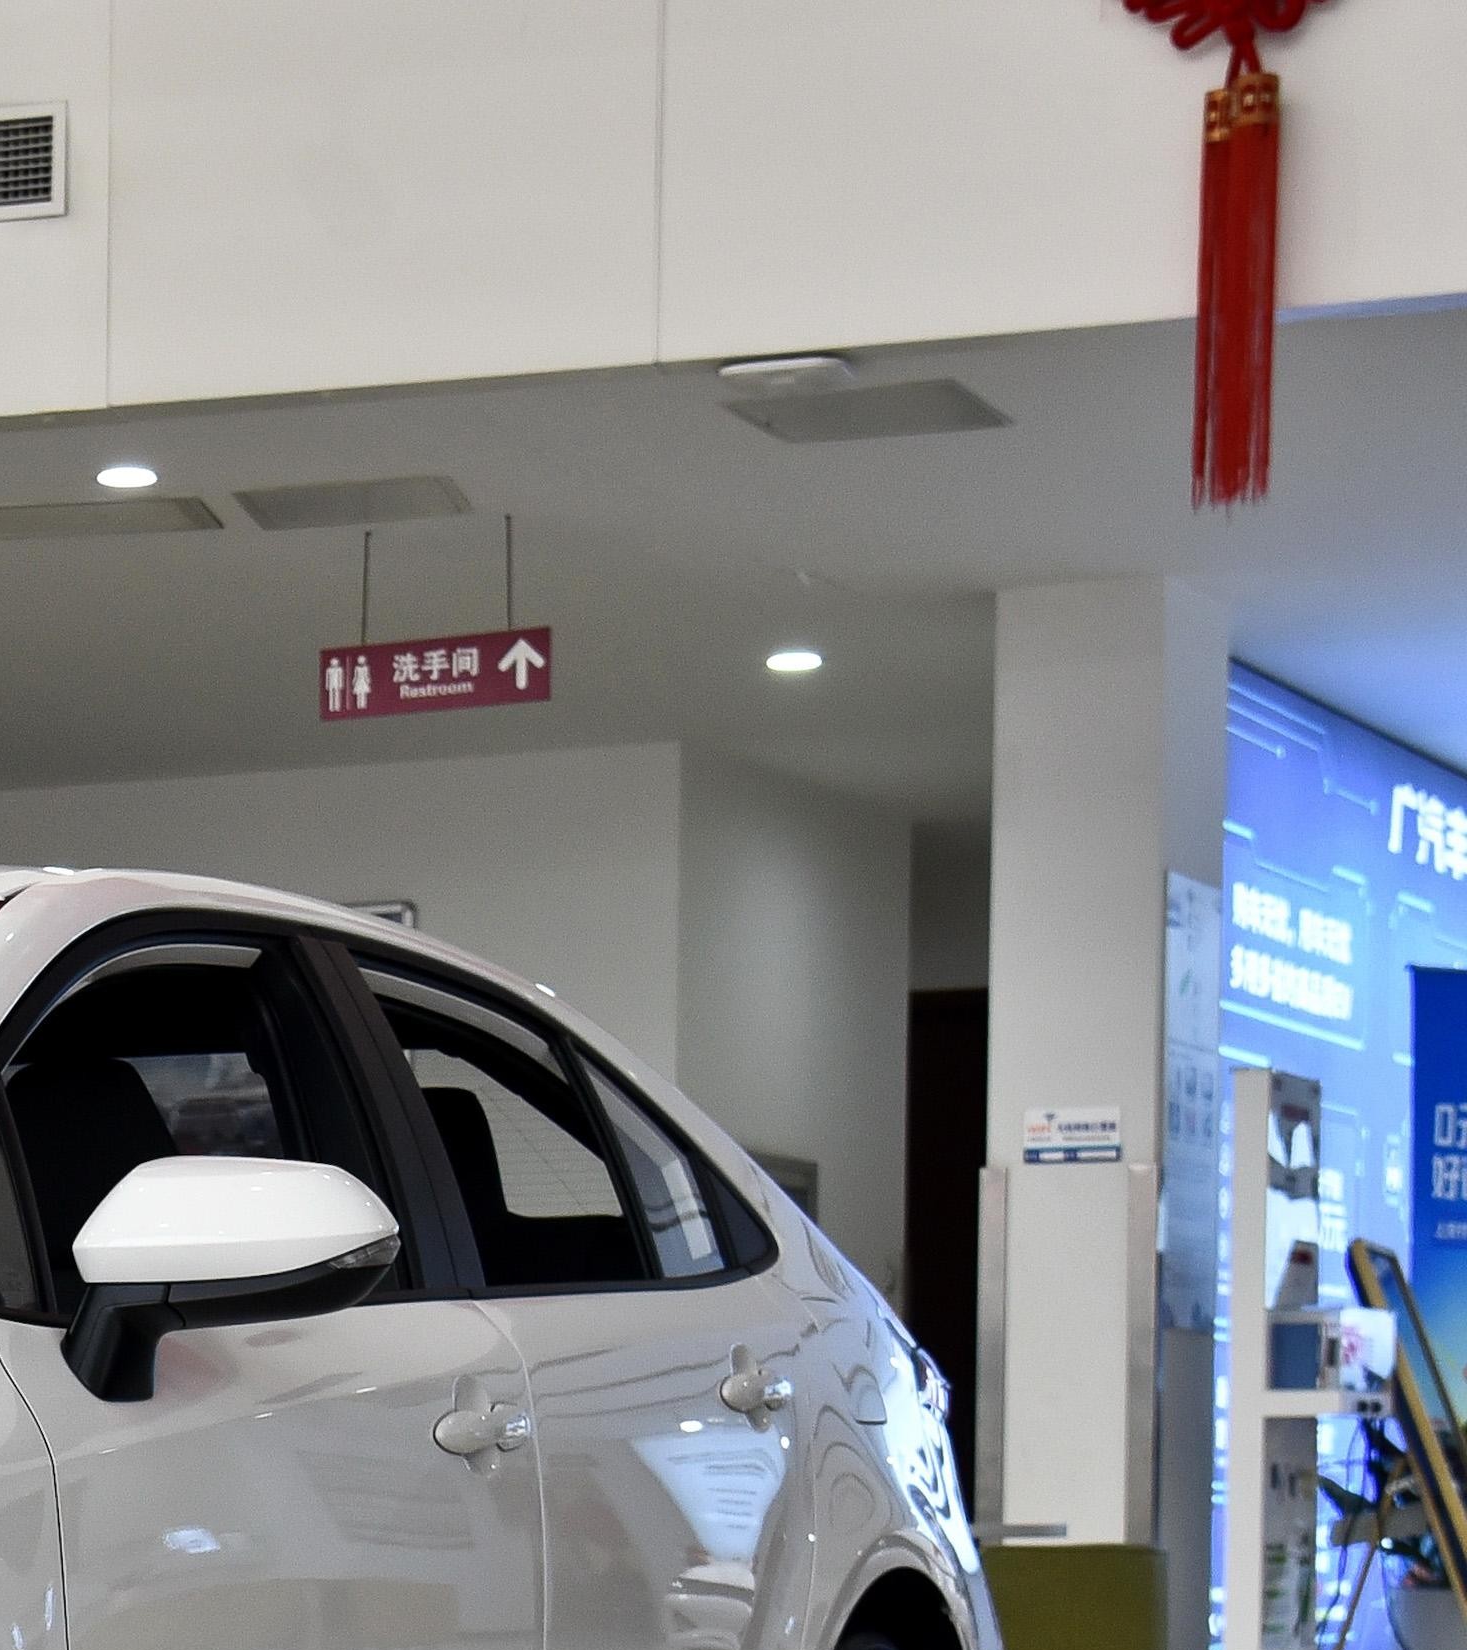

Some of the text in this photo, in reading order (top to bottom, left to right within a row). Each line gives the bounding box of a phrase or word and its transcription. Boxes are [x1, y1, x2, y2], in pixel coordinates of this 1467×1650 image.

[393, 647, 479, 682] 洗手间
[400, 682, 474, 699] Restroom
